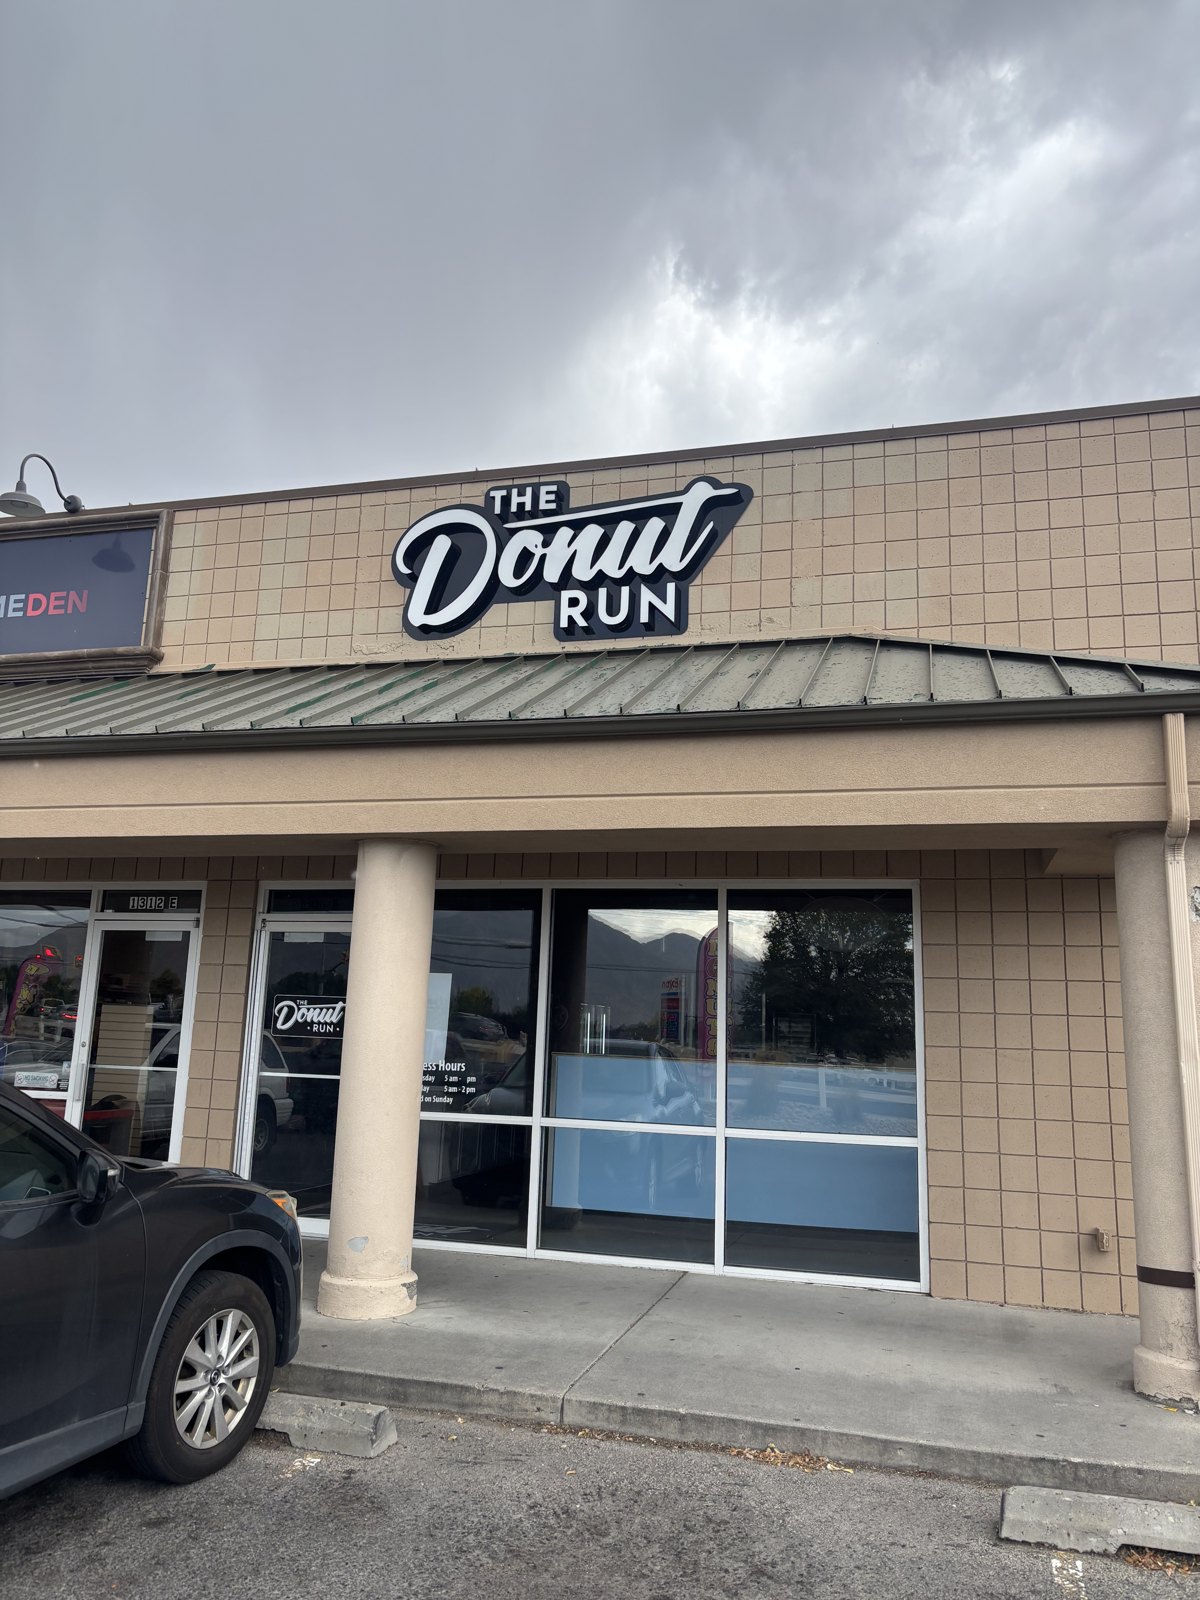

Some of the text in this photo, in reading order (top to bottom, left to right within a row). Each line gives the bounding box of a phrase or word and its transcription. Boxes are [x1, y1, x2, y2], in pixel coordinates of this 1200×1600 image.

[490, 485, 558, 514] THE
[396, 481, 739, 627] Donut
[559, 582, 676, 628] RUN
[129, 896, 178, 910] 1312 E
[275, 1000, 346, 1030] Donut
[312, 1023, 334, 1033] RUN
[438, 1060, 466, 1072] Hours
[444, 1074, 448, 1082] 5
[466, 1076, 476, 1084] pm
[444, 1085, 448, 1093] 5
[461, 1085, 465, 1093] 2
[432, 1095, 453, 1105] Sunday
